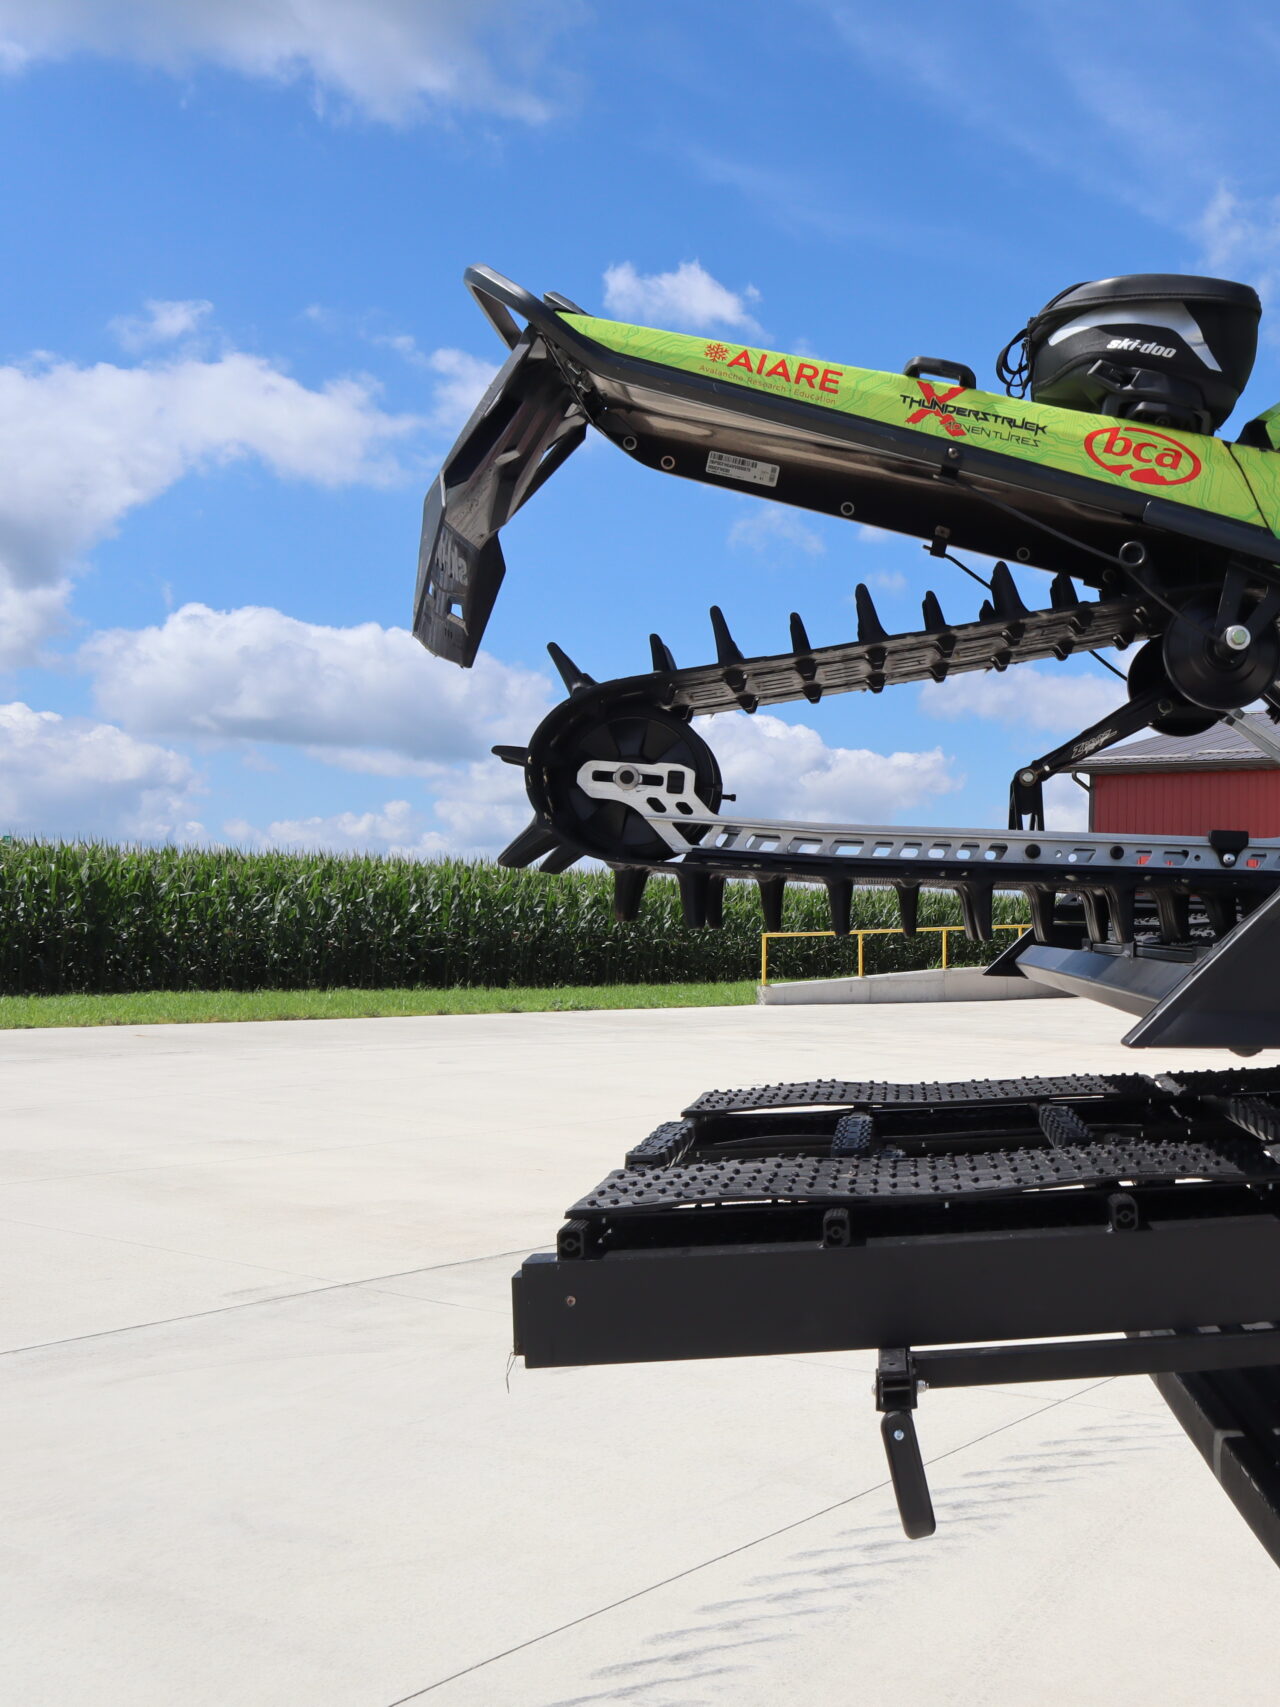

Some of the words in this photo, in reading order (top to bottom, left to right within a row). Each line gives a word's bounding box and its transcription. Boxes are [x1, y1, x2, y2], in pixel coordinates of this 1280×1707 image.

[1106, 338, 1177, 359] ski-doo
[699, 364, 745, 383] Avalanche
[793, 388, 837, 405] Education
[726, 349, 844, 395] AIARE
[900, 394, 1049, 437] THUNDERSTRUCK
[1103, 427, 1183, 470] bca
